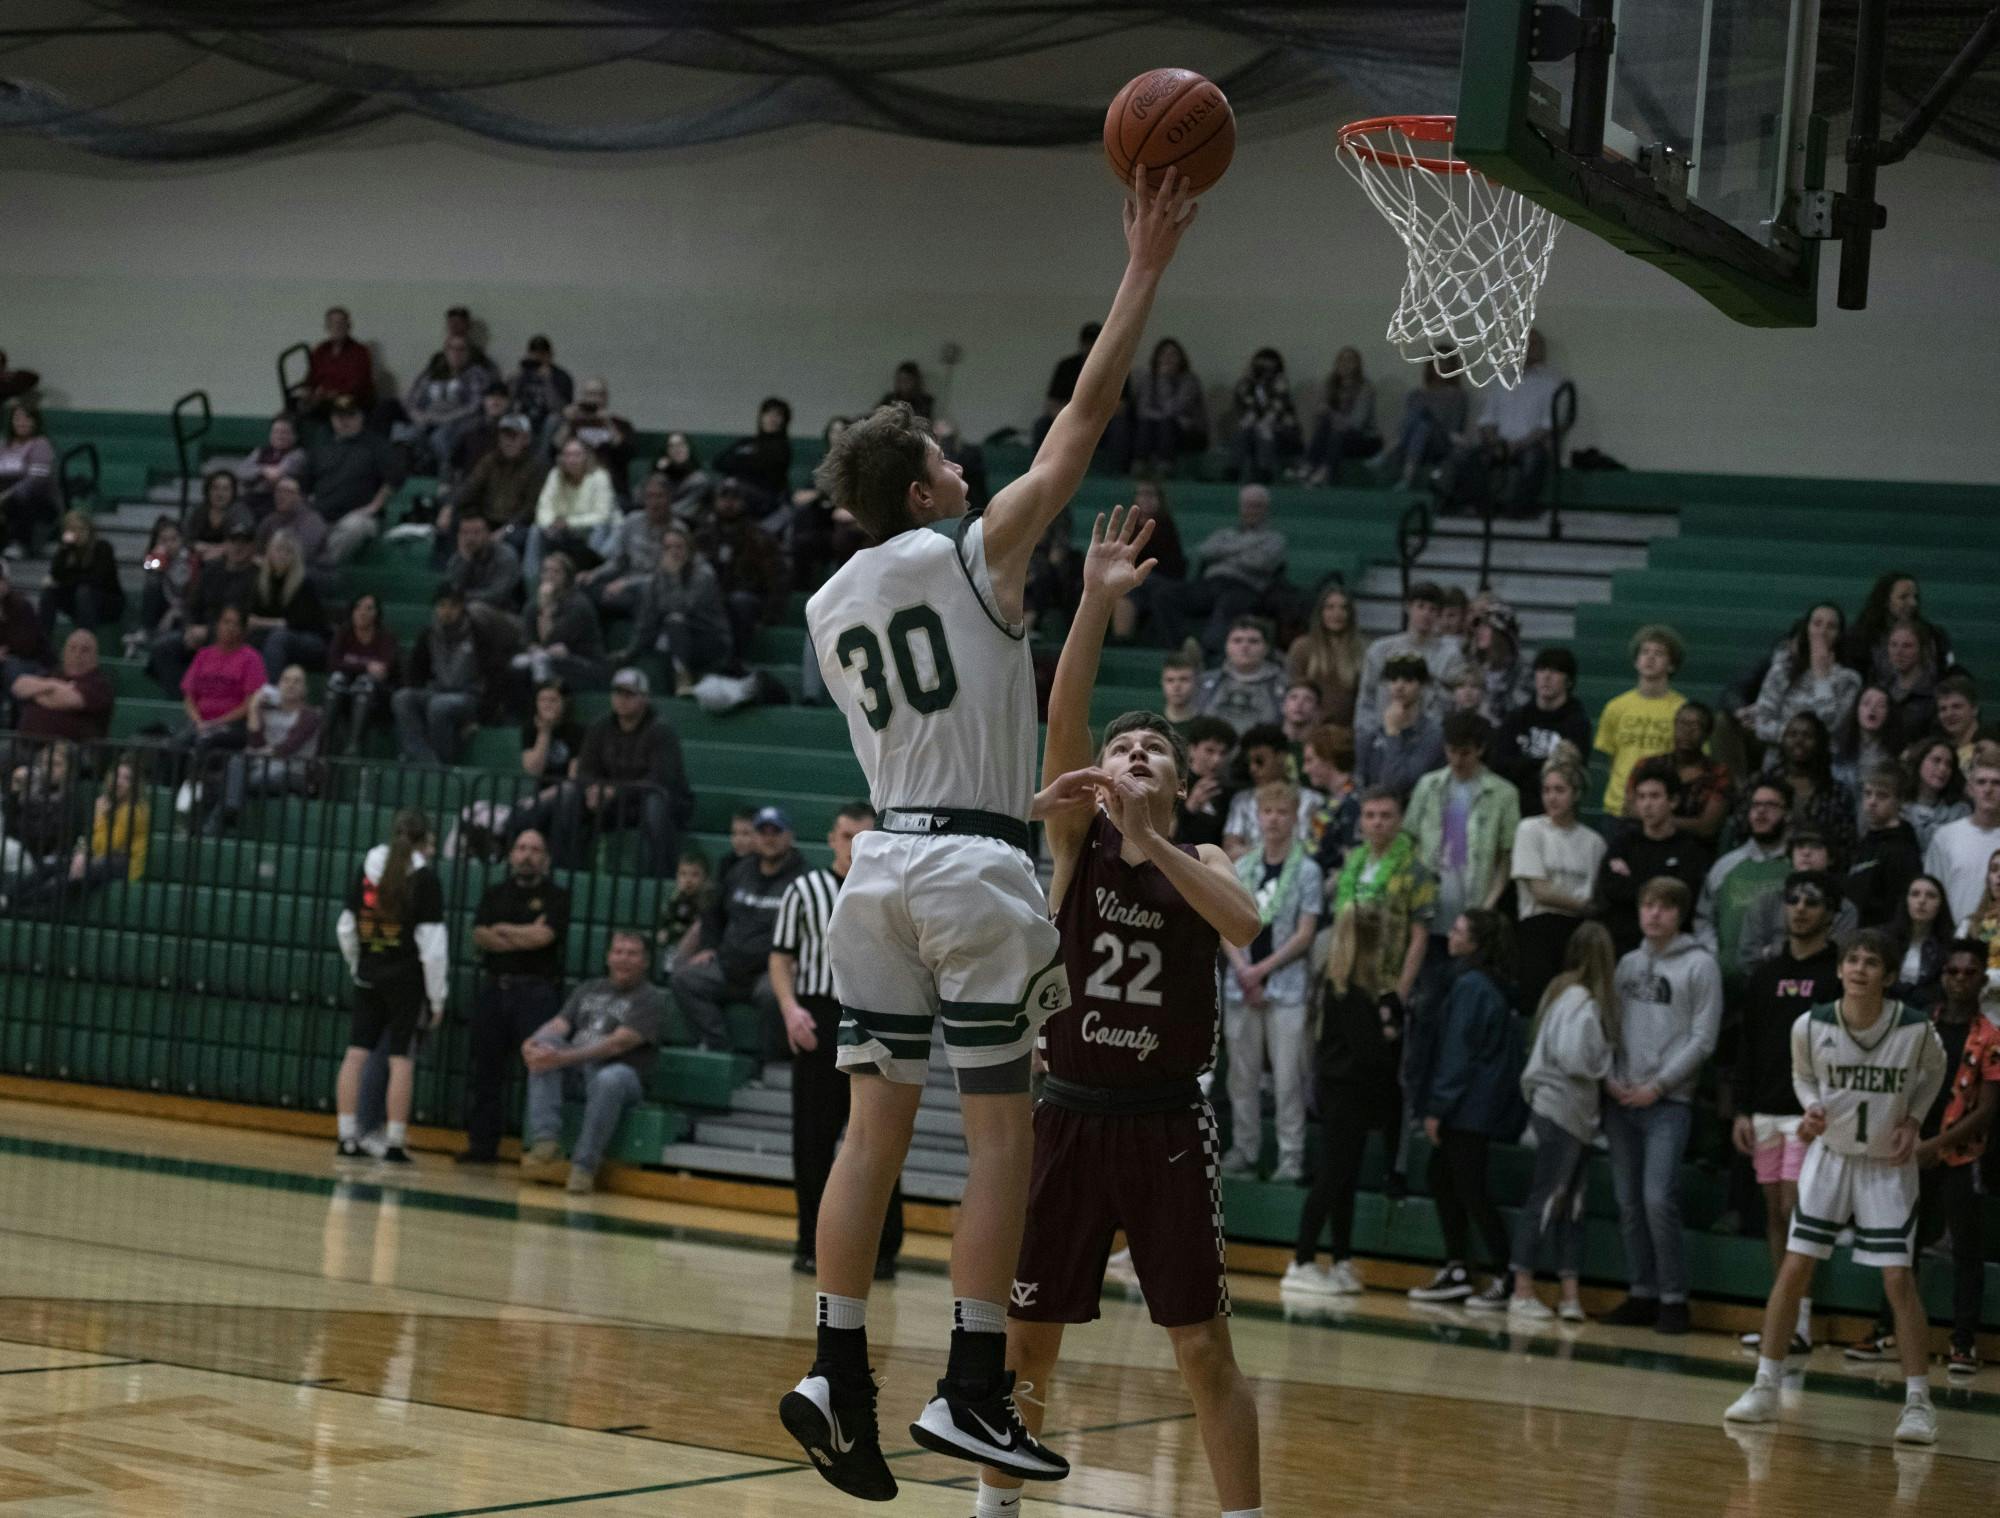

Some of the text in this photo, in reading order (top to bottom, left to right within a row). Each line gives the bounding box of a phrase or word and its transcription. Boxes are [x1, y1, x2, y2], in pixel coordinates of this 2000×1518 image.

[836, 602, 959, 732] 30
[1095, 886, 1165, 930] Vinton
[1084, 931, 1162, 1007] 22
[1081, 1010, 1160, 1062] County
[1855, 1101, 1868, 1142] 1
